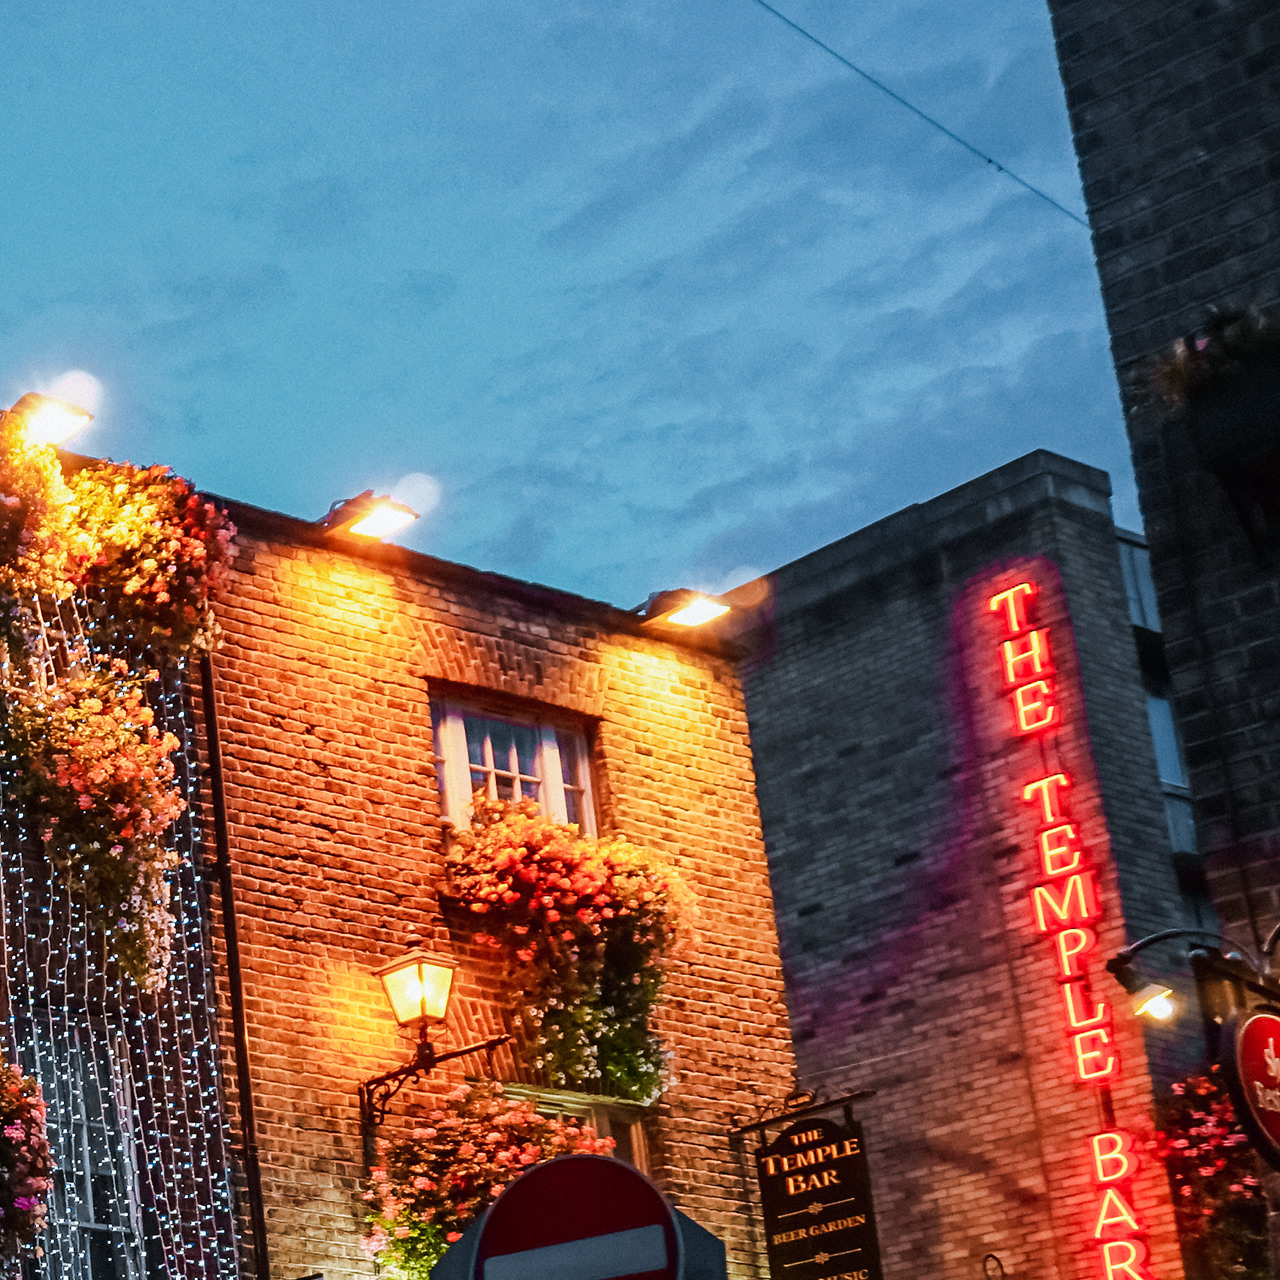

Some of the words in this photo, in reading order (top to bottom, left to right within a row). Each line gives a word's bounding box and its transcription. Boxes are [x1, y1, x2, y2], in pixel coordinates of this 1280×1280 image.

[988, 582, 1056, 732] THE
[1022, 772, 1117, 1081] TEMPLE
[790, 1128, 824, 1147] THE
[761, 1138, 860, 1176] TEMPLE
[785, 1169, 841, 1197] BAR
[772, 1228, 813, 1246] BEER
[809, 1213, 866, 1237] GARDEN
